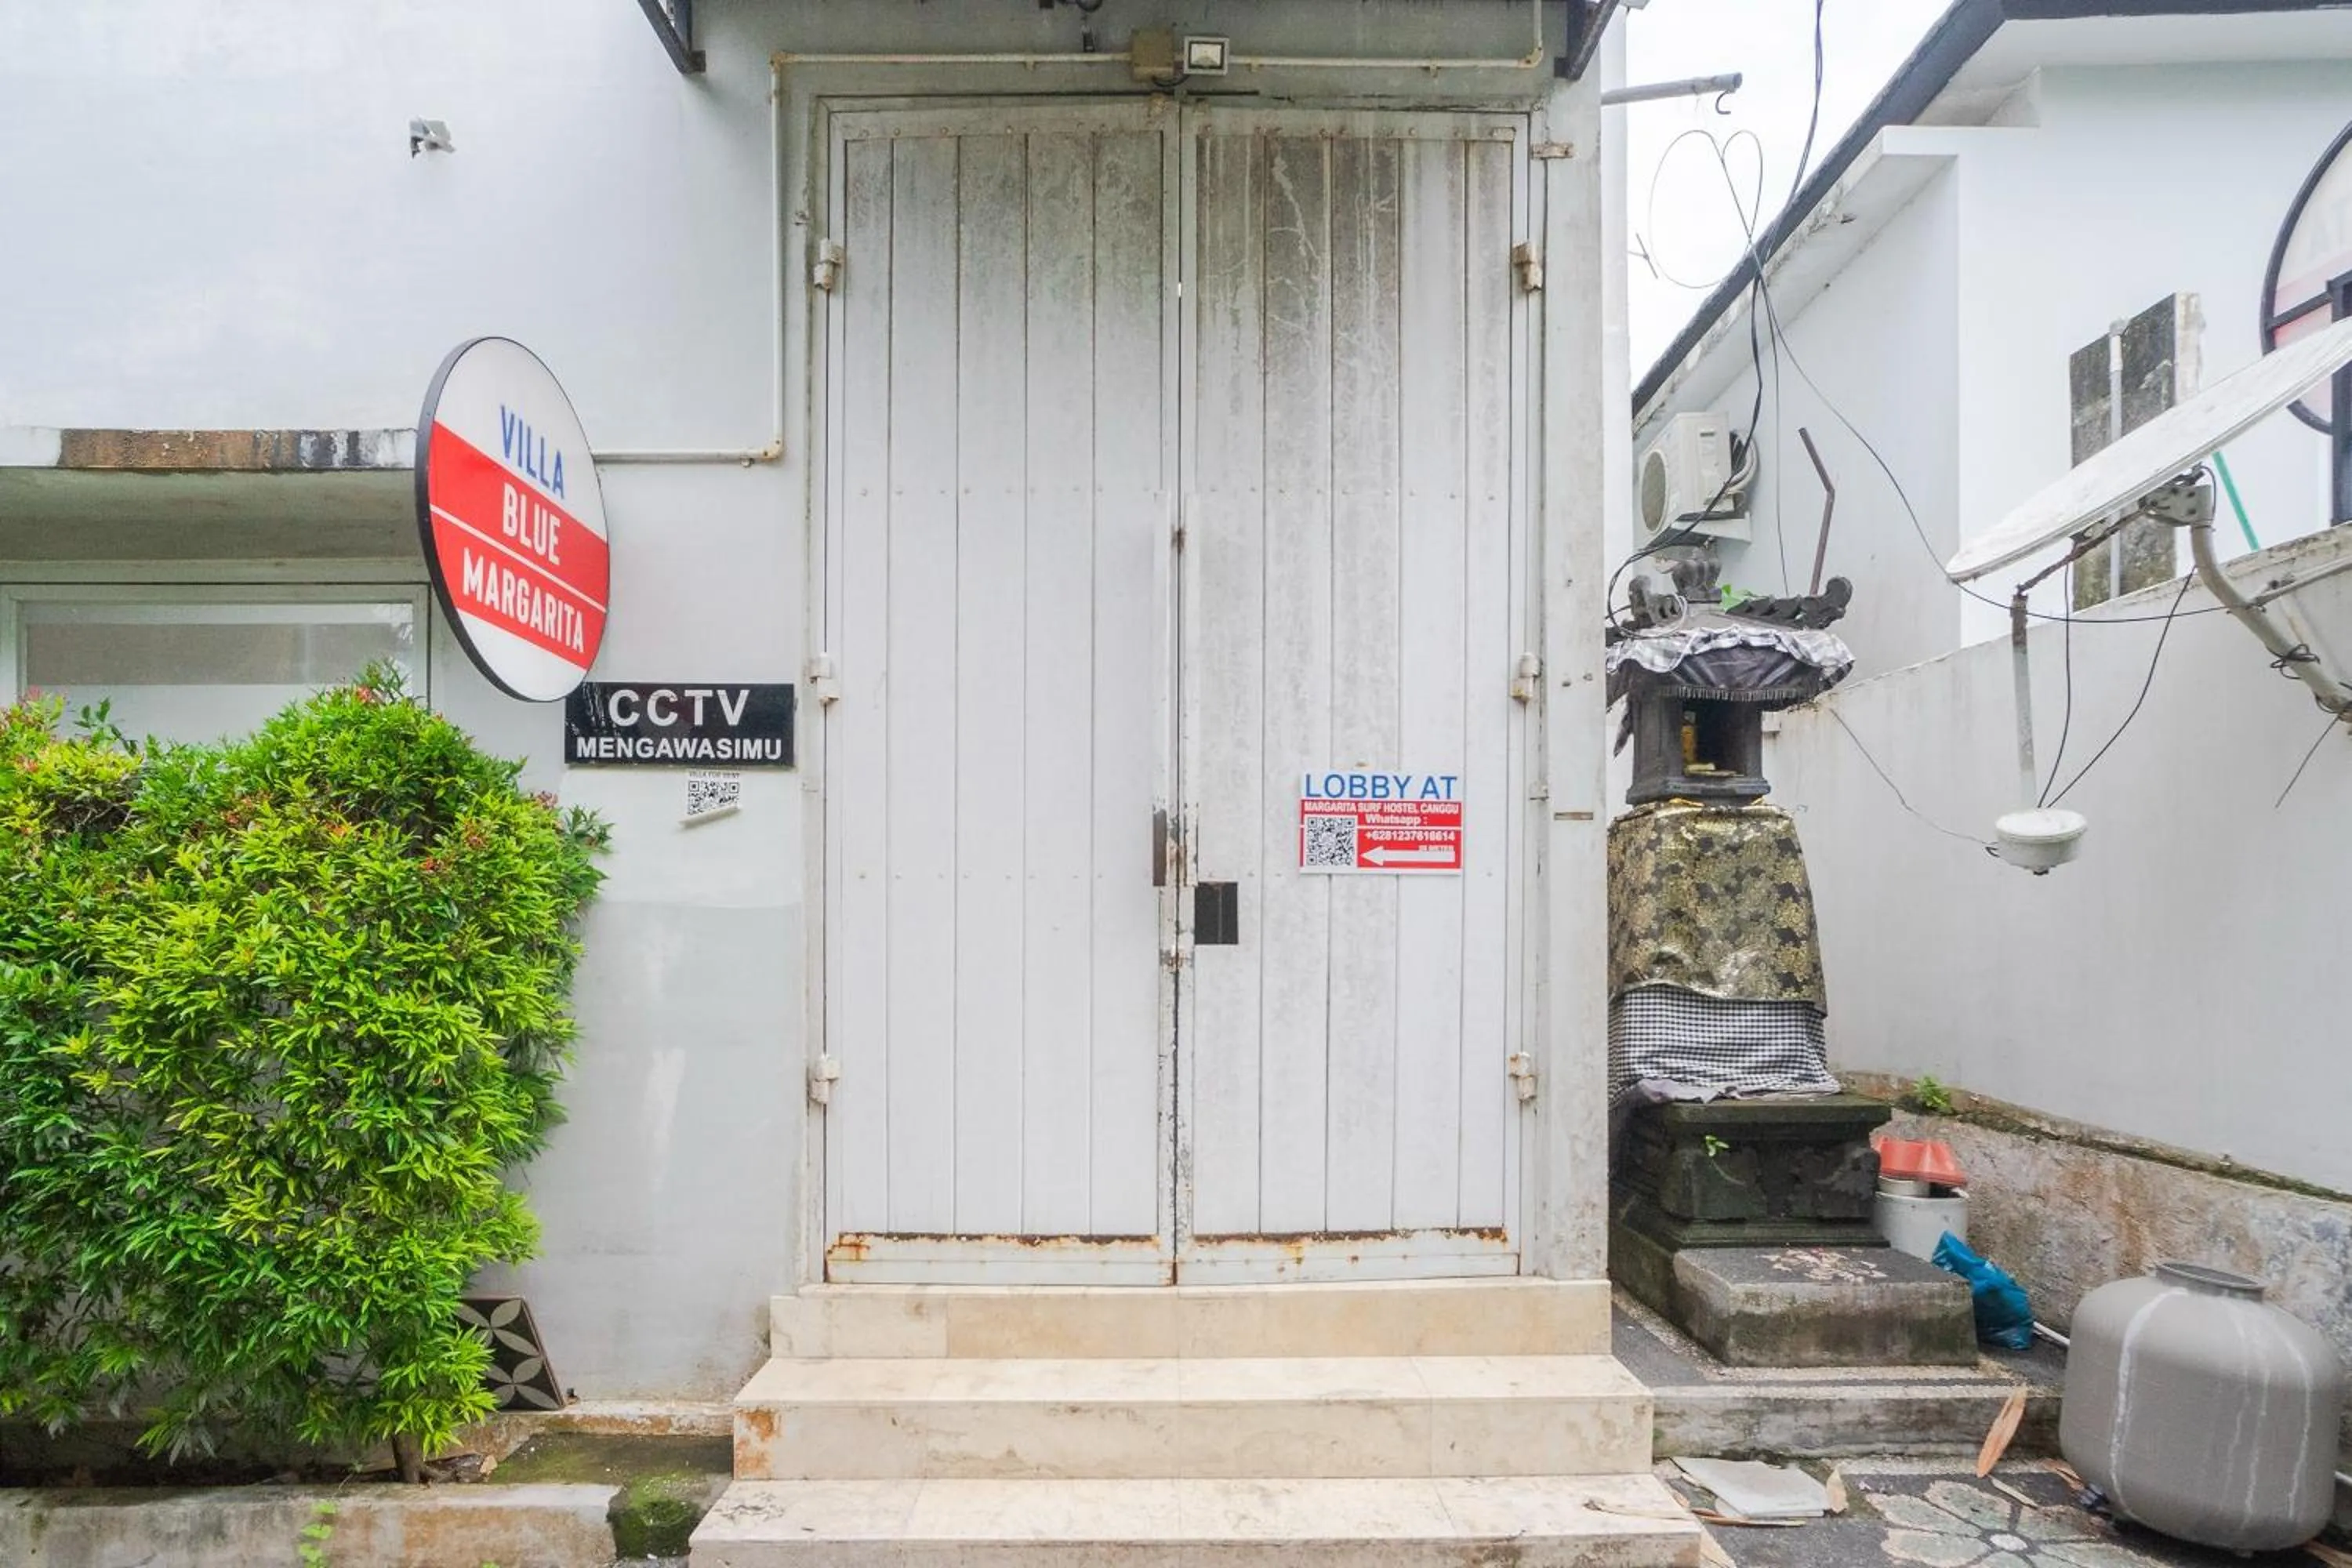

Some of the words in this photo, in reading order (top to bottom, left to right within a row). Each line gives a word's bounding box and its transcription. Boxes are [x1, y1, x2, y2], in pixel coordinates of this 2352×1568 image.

[500, 404, 564, 499] VILLA
[502, 482, 561, 565] BLUE
[462, 547, 585, 653] MARGARITA
[608, 689, 750, 727] CCTV
[576, 737, 782, 760] MENGAWASIMU
[1305, 773, 1412, 799] LOBBY
[1420, 775, 1457, 800] AT
[1304, 801, 1356, 813] MARGARITA
[1357, 802, 1382, 813] SURF
[1383, 802, 1418, 814] HOSTEL
[1420, 803, 1459, 815] CANGGU
[1365, 813, 1421, 826] Whatsapp
